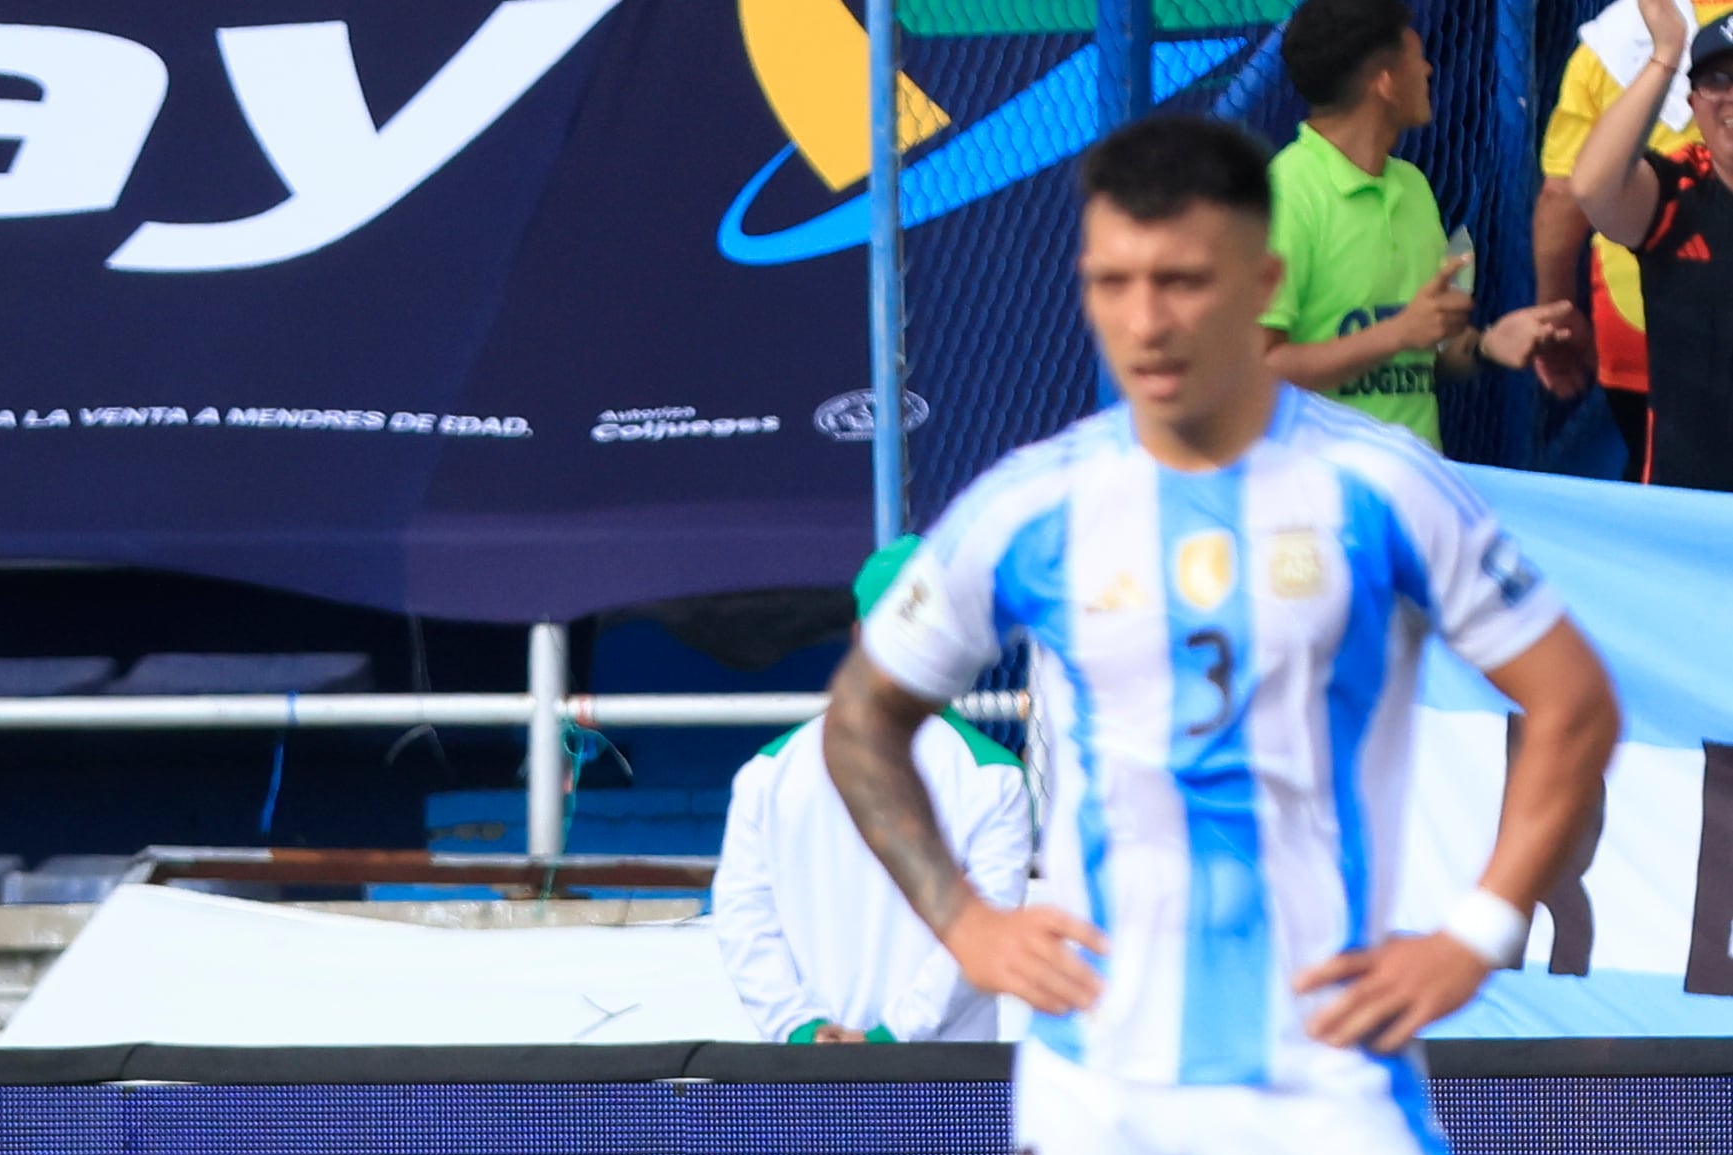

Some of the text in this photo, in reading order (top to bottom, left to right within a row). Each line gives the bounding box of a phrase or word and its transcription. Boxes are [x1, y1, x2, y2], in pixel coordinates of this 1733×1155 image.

[22, 408, 71, 429] LA
[78, 406, 189, 427] VENTA
[192, 406, 222, 427] A
[224, 406, 387, 432] MENORES
[388, 411, 439, 435] DE
[1185, 628, 1232, 737] 3
